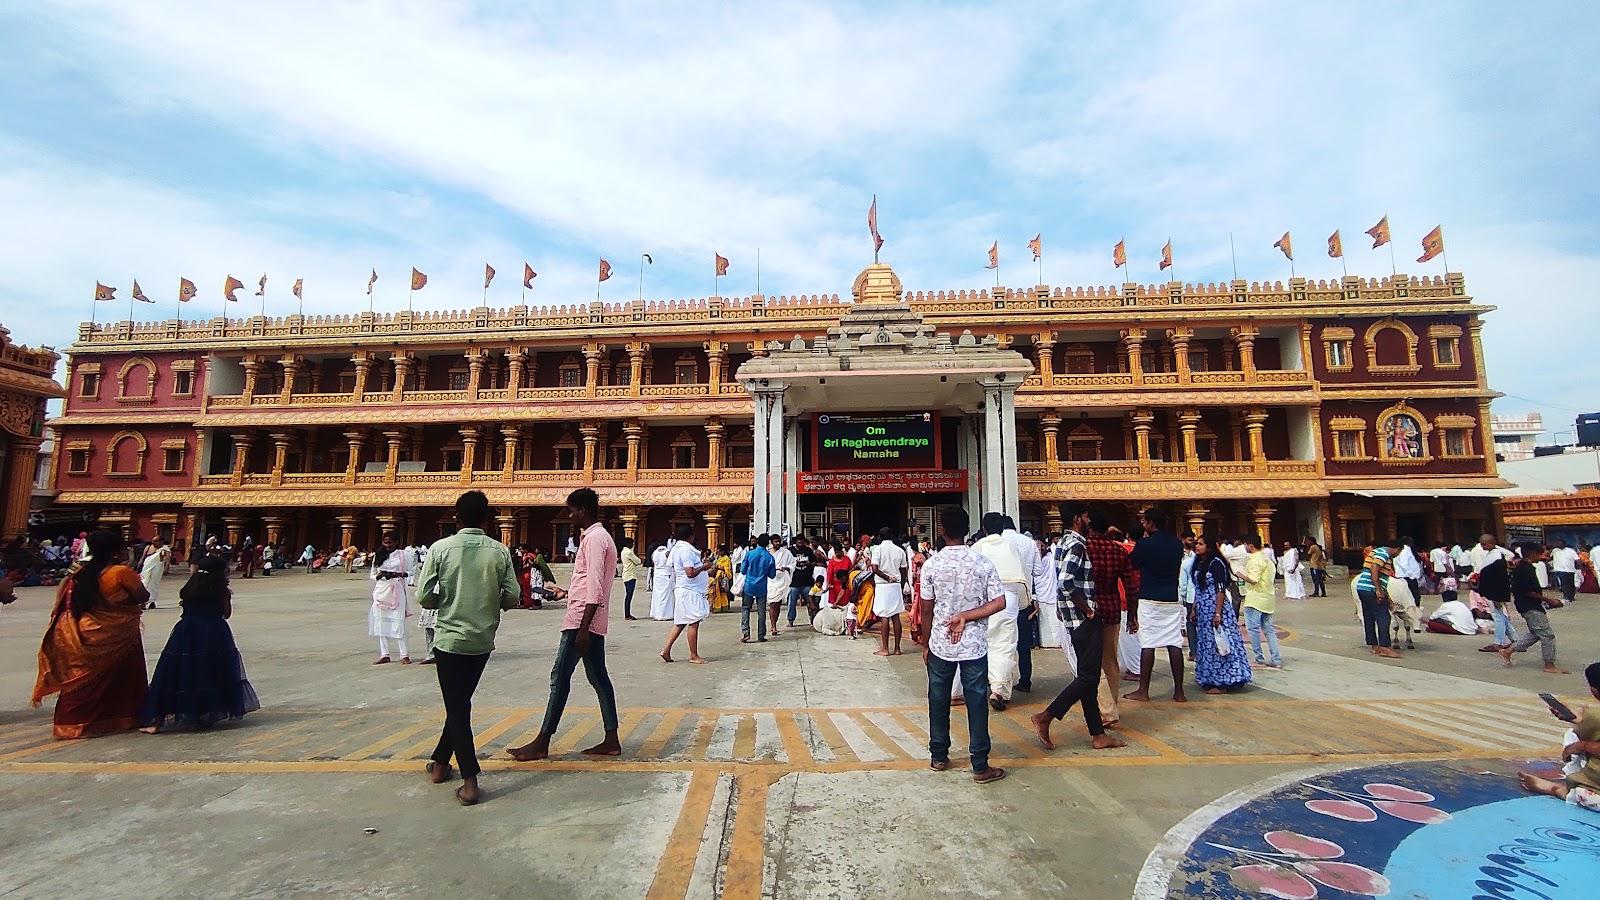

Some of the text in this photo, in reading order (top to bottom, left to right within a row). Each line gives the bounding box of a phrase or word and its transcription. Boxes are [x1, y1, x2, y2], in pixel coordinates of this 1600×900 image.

[866, 426, 885, 435] Om
[824, 437, 929, 449] Sri Raghavendraya
[853, 449, 900, 459] Namaha
